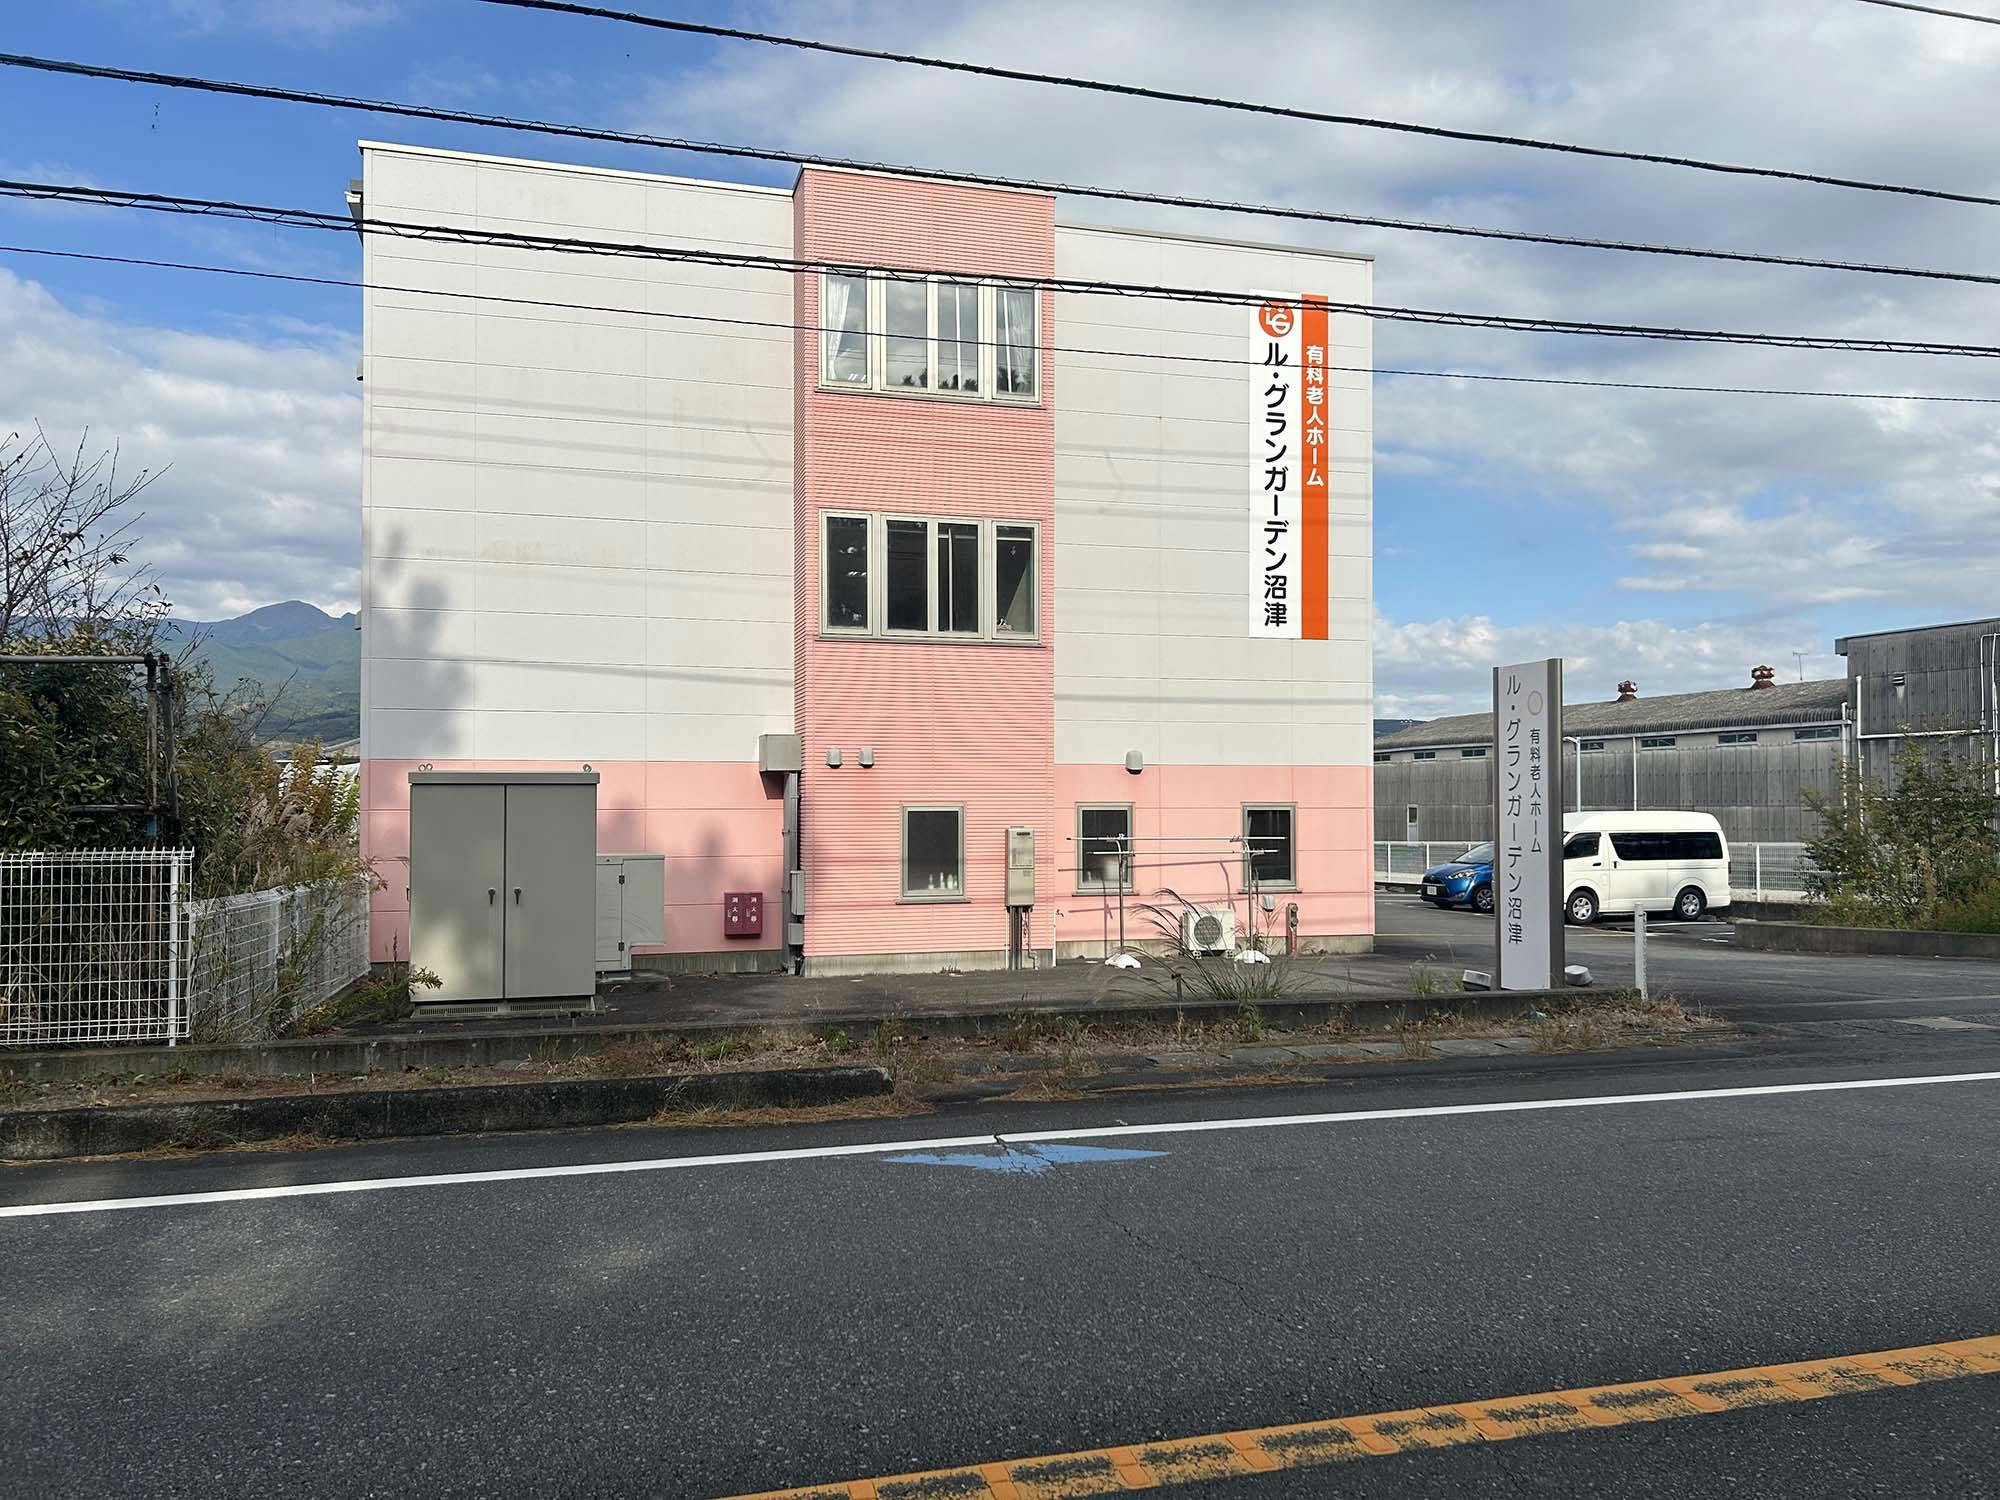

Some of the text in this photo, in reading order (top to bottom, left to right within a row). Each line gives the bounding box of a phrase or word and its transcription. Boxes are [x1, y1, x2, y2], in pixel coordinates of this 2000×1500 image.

[1306, 344, 1325, 487] 有料老人ホーム
[1529, 728, 1542, 853] 有料老人ホーム
